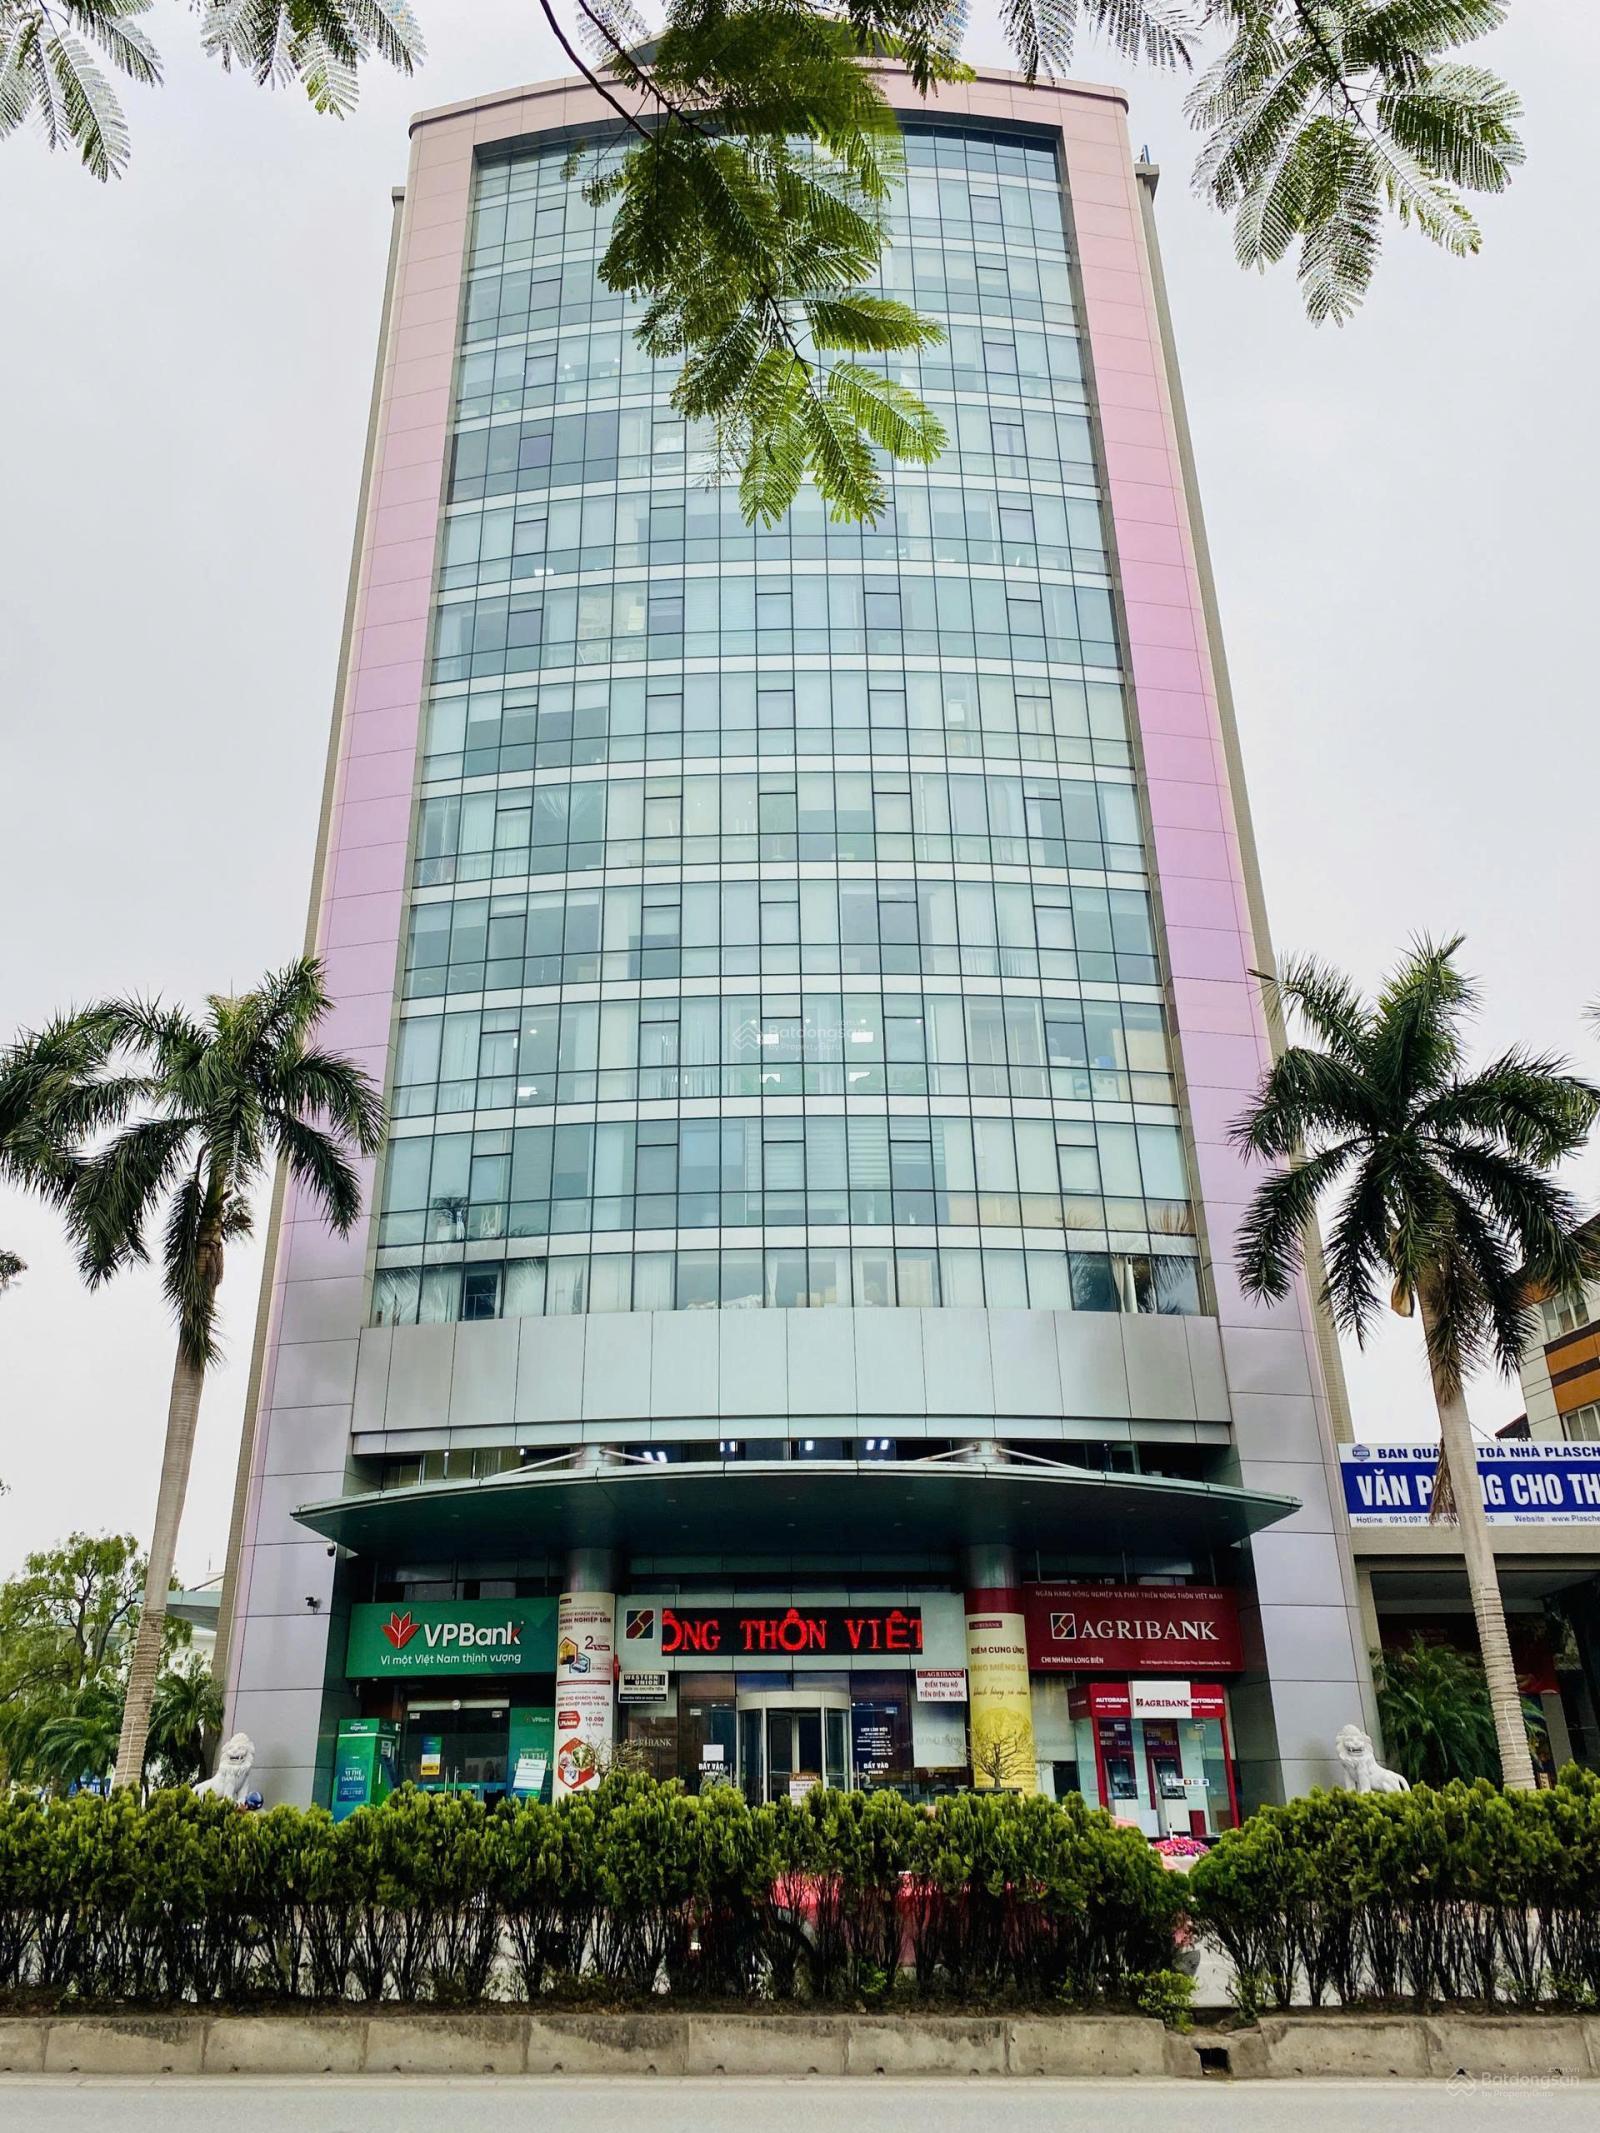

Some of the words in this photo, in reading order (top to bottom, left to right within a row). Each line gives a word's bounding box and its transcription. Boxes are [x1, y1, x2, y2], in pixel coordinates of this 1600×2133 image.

[1377, 1448, 1408, 1459] BAN
[1476, 1446, 1509, 1458] TOÀ
[1510, 1445, 1541, 1458] NHÀ
[1356, 1468, 1412, 1506] VĂN
[1510, 1473, 1563, 1505] CHO
[1356, 1516, 1383, 1524] Hotline
[1389, 1516, 1407, 1524] 0913
[1514, 1514, 1545, 1523] Website
[424, 1622, 520, 1647] VPBank
[740, 1607, 827, 1651] THÔN
[1080, 1620, 1220, 1640] AGRIBANK
[585, 1635, 594, 1650] 2
[381, 1655, 390, 1665] Vì
[392, 1654, 412, 1666] một
[414, 1653, 435, 1666] Việt
[436, 1655, 459, 1664] Nam
[462, 1653, 487, 1665] thịnh
[490, 1653, 521, 1665] vượng
[1052, 1655, 1073, 1664] NHÁNH
[1090, 1655, 1104, 1664] BIÊN
[1145, 1700, 1190, 1708] AGRIBANK
[876, 1761, 889, 1769] VÀO
